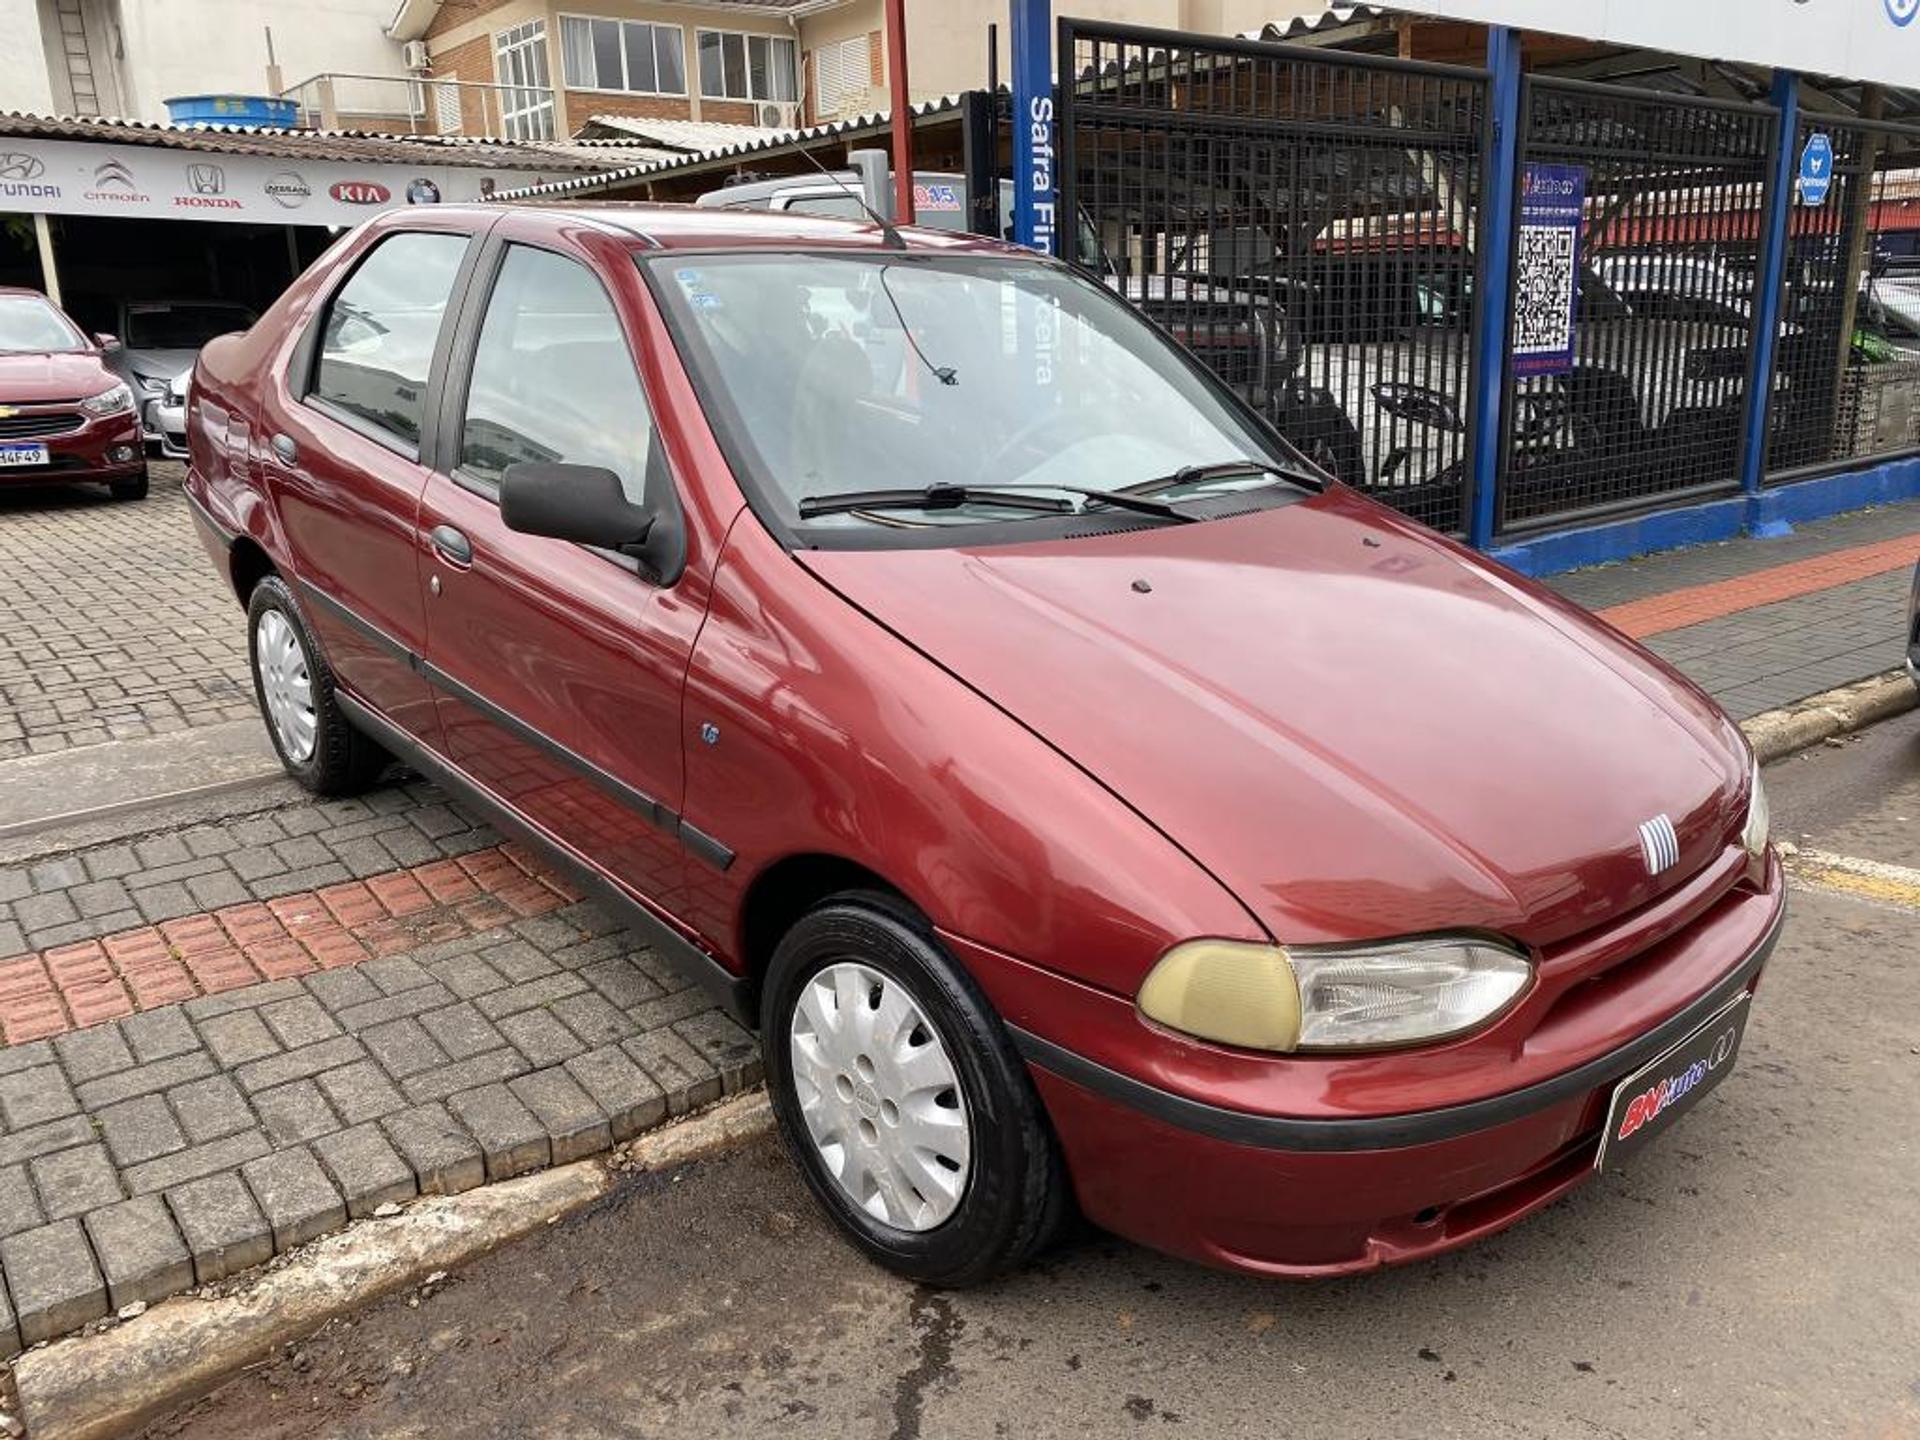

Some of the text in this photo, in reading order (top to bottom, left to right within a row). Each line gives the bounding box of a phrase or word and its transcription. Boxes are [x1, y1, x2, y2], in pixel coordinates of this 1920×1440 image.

[1030, 96, 1055, 192] Safra
[267, 185, 310, 195] NISSAN
[339, 185, 381, 202] KIA
[173, 196, 244, 209] HONDA
